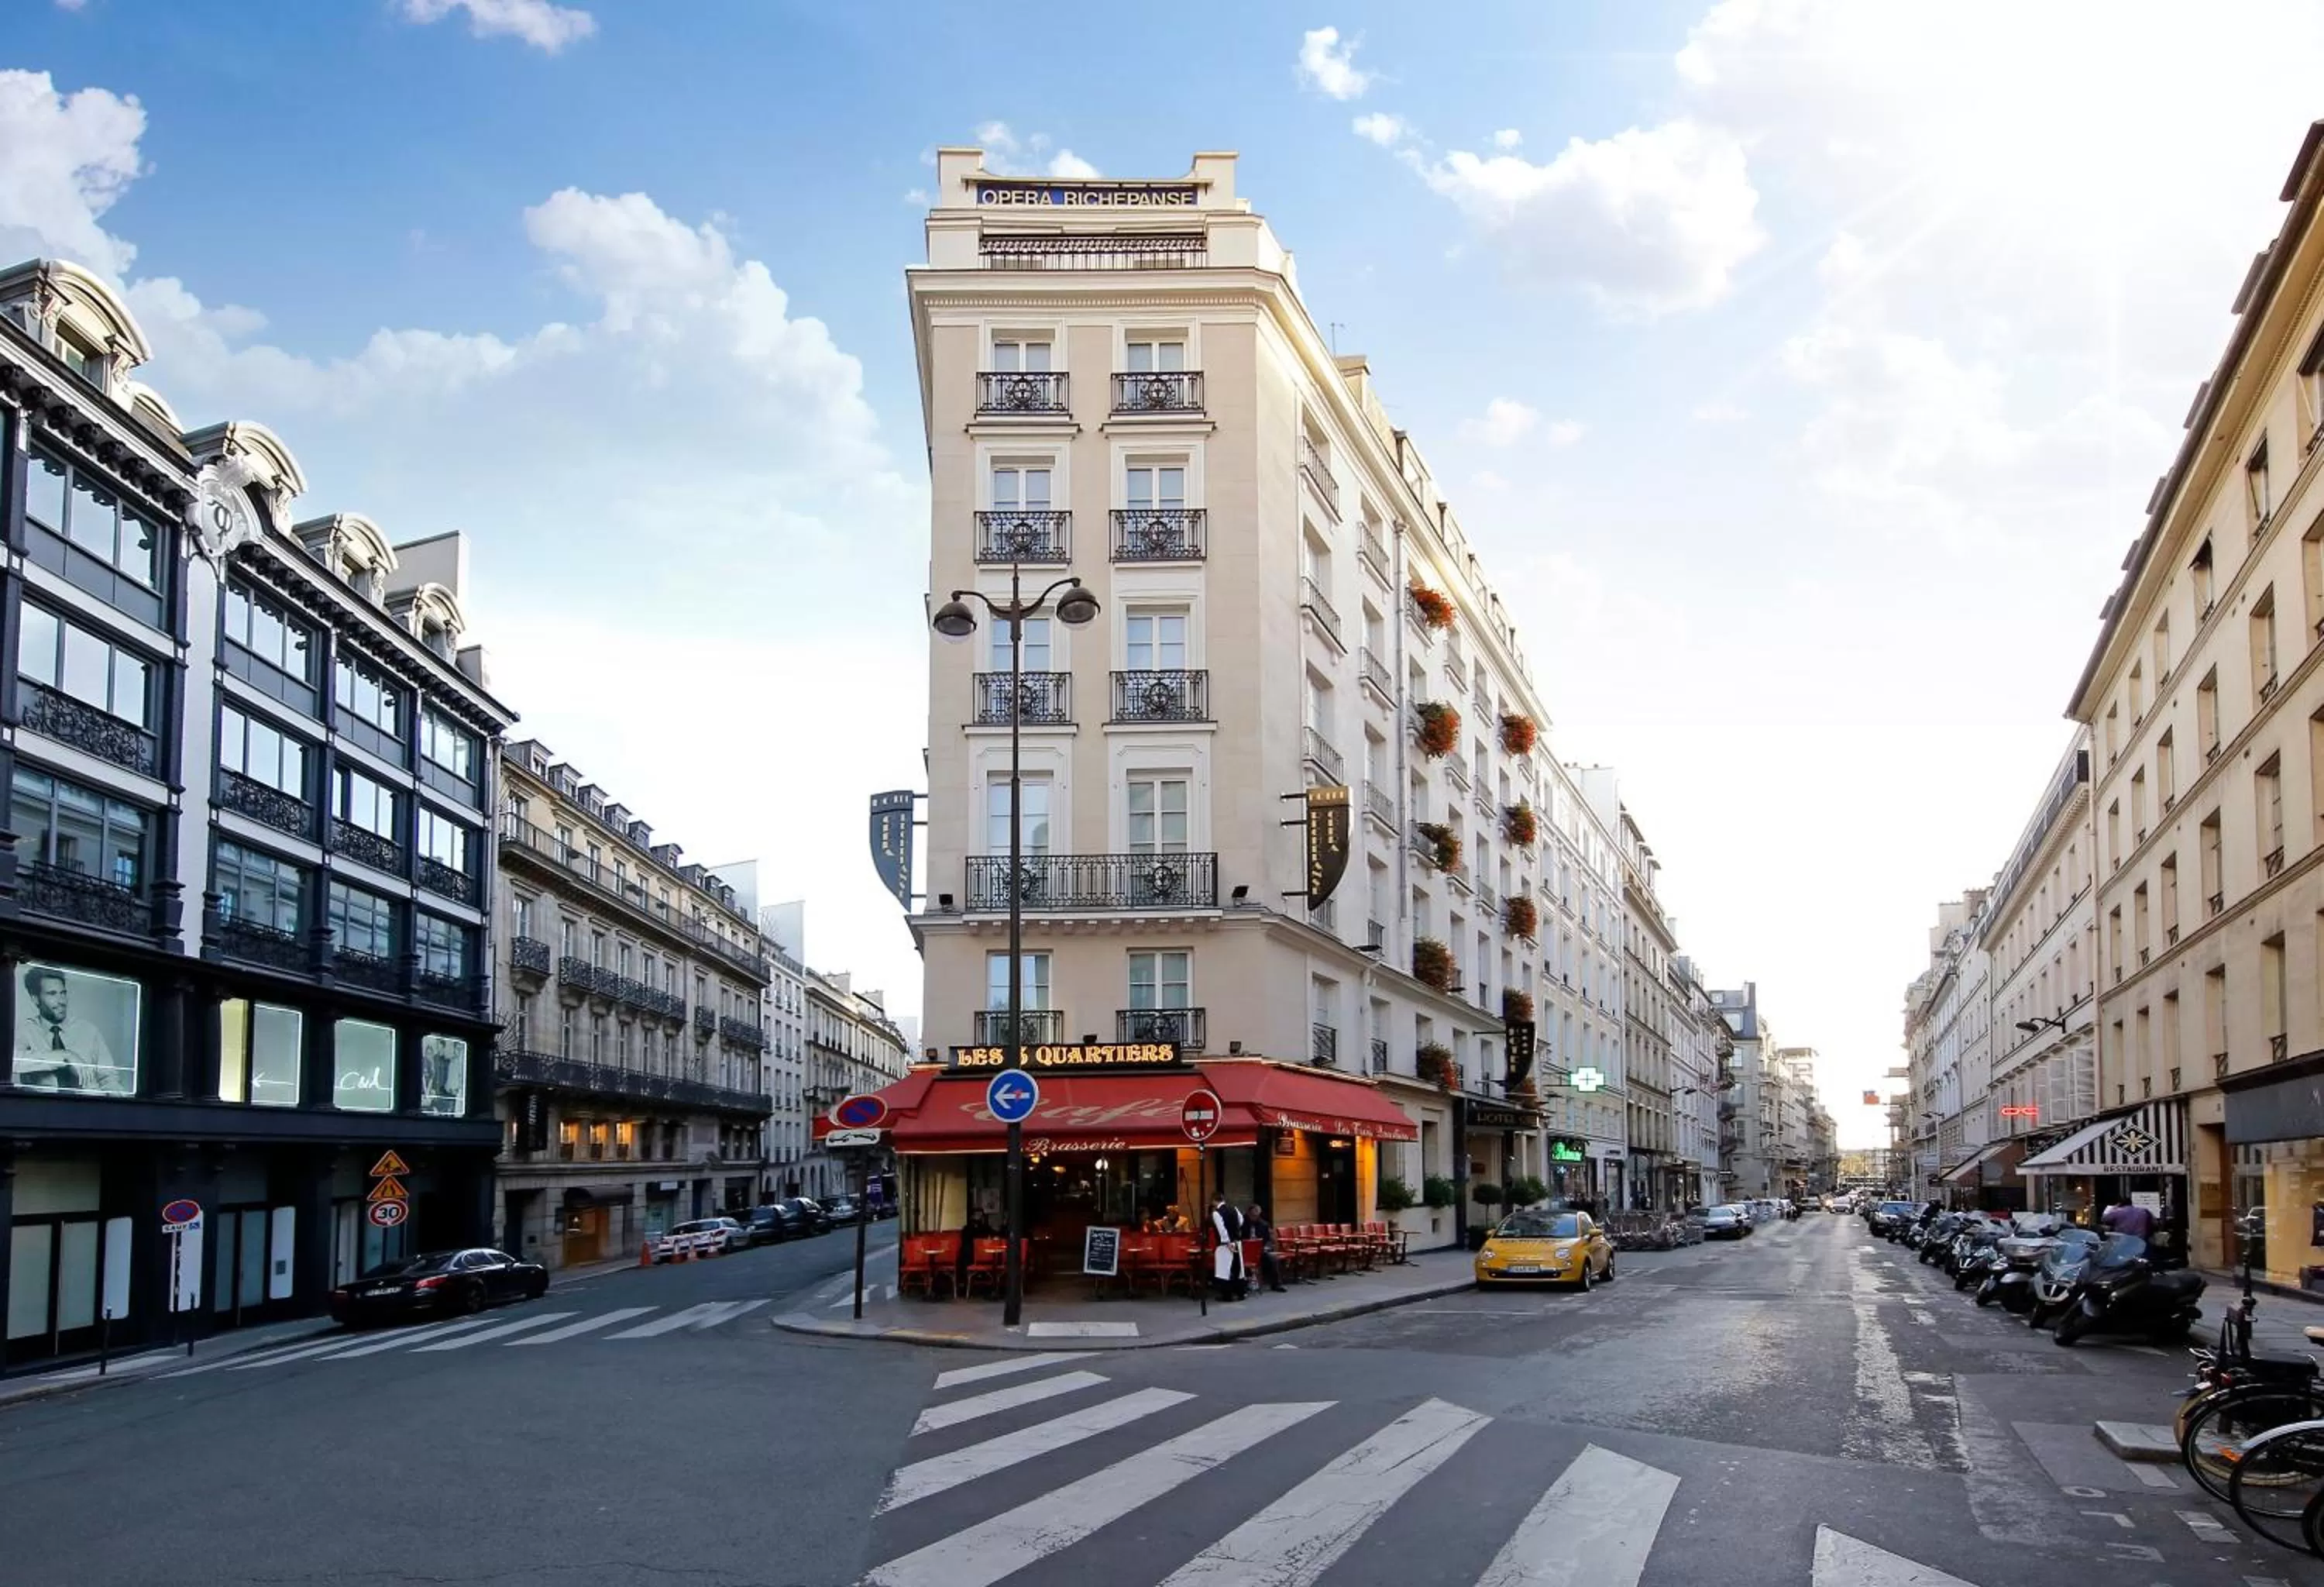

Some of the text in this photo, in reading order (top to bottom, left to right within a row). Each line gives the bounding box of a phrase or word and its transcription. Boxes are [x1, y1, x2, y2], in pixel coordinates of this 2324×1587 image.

[982, 189, 1192, 205] OPERA RICHEPANSE
[957, 1048, 1004, 1065] LES
[1035, 1043, 1174, 1066] QUARTIERS
[1025, 1137, 1129, 1154] Brasserie
[377, 1207, 399, 1219] 30
